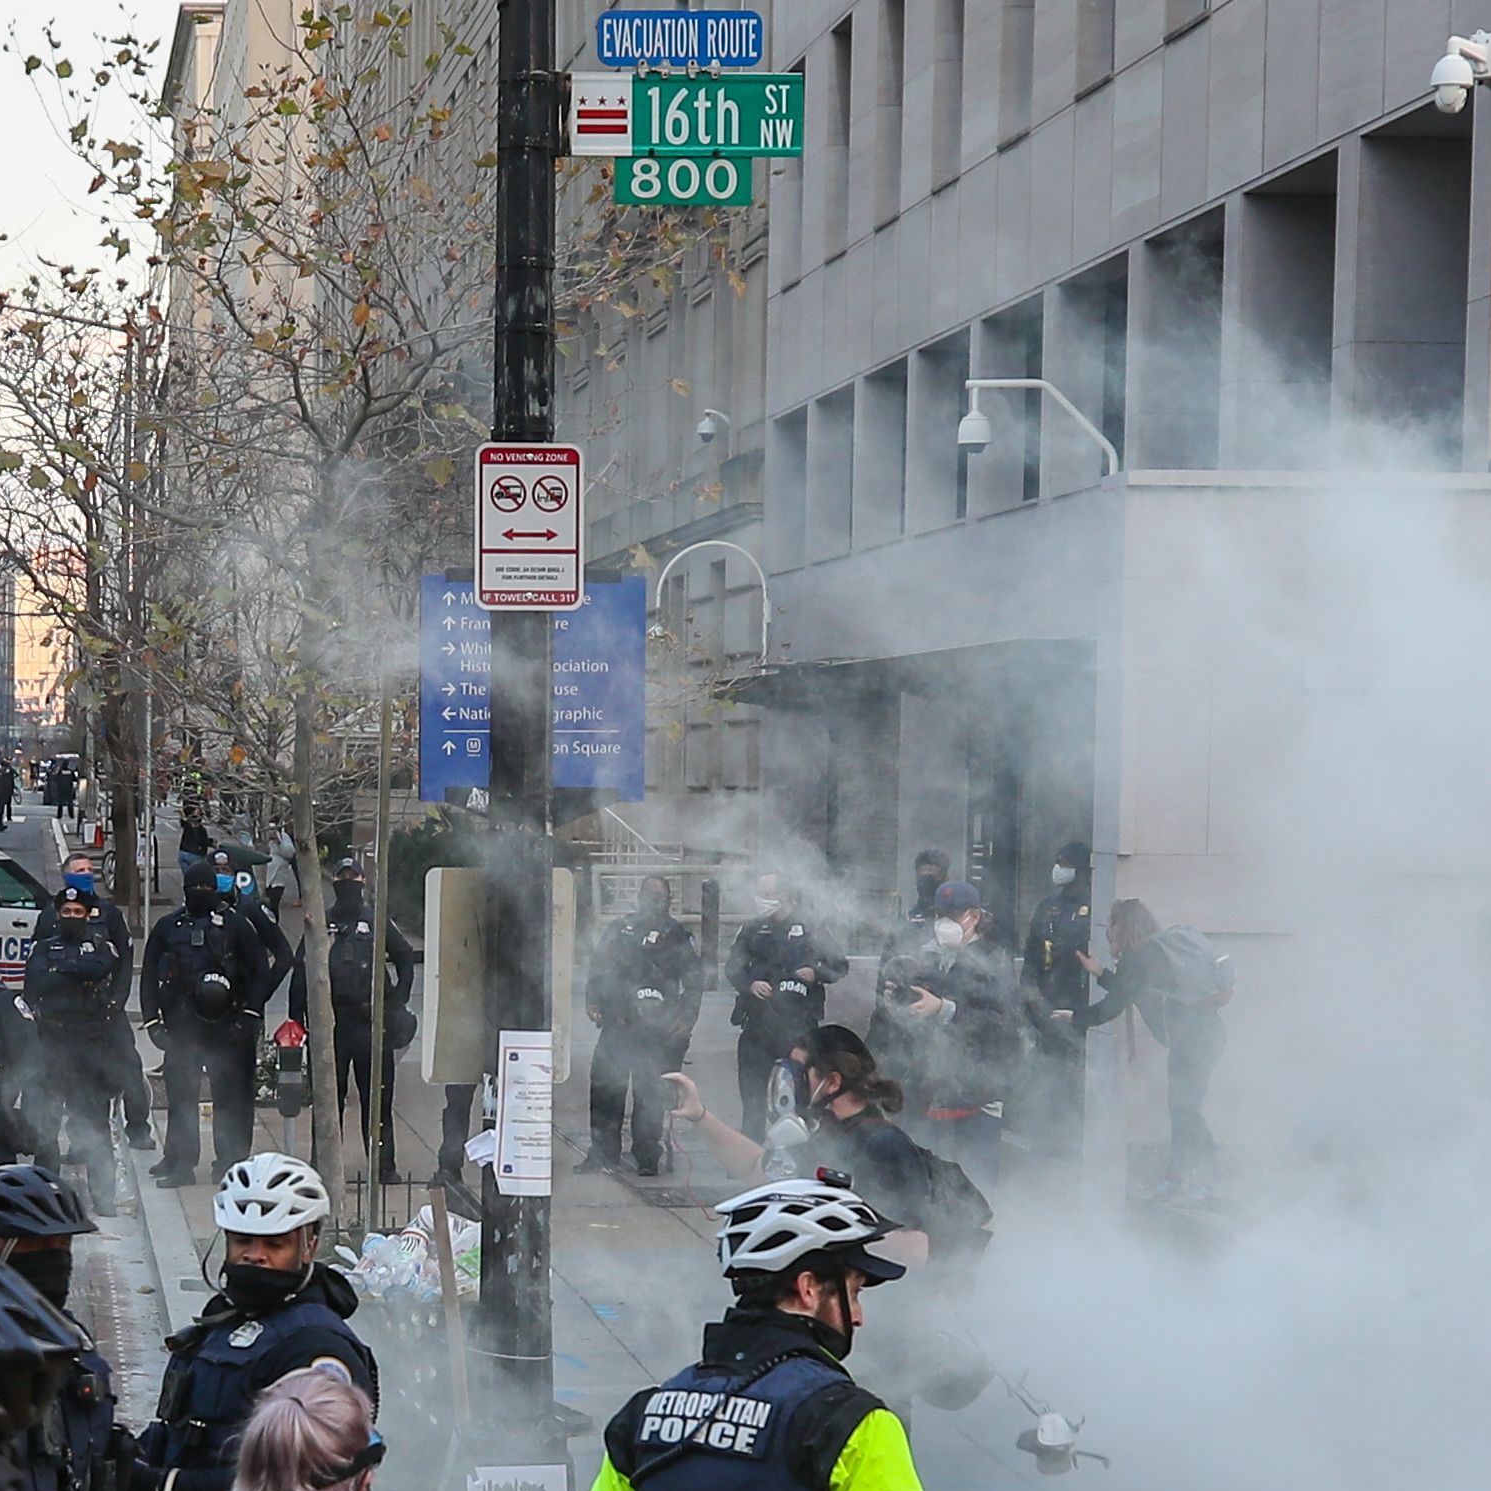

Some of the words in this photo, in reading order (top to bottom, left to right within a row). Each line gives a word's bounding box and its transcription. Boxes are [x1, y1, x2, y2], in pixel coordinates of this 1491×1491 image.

[603, 18, 699, 58] EVACUATION
[707, 18, 758, 58] ROUTE
[764, 85, 790, 114] ST
[647, 87, 740, 145] 16th
[760, 119, 794, 149] NW
[630, 158, 739, 199] 800
[490, 453, 504, 462] NO
[545, 453, 569, 462] ZONE
[483, 593, 491, 602] IF
[494, 593, 529, 602] TOWED
[531, 593, 557, 602] CALL
[560, 593, 575, 602] 311
[460, 618, 491, 629] Fran
[460, 643, 492, 654] Whit
[553, 660, 608, 672] ociation
[460, 683, 487, 696] The
[554, 685, 578, 696] use
[573, 740, 621, 757] Square
